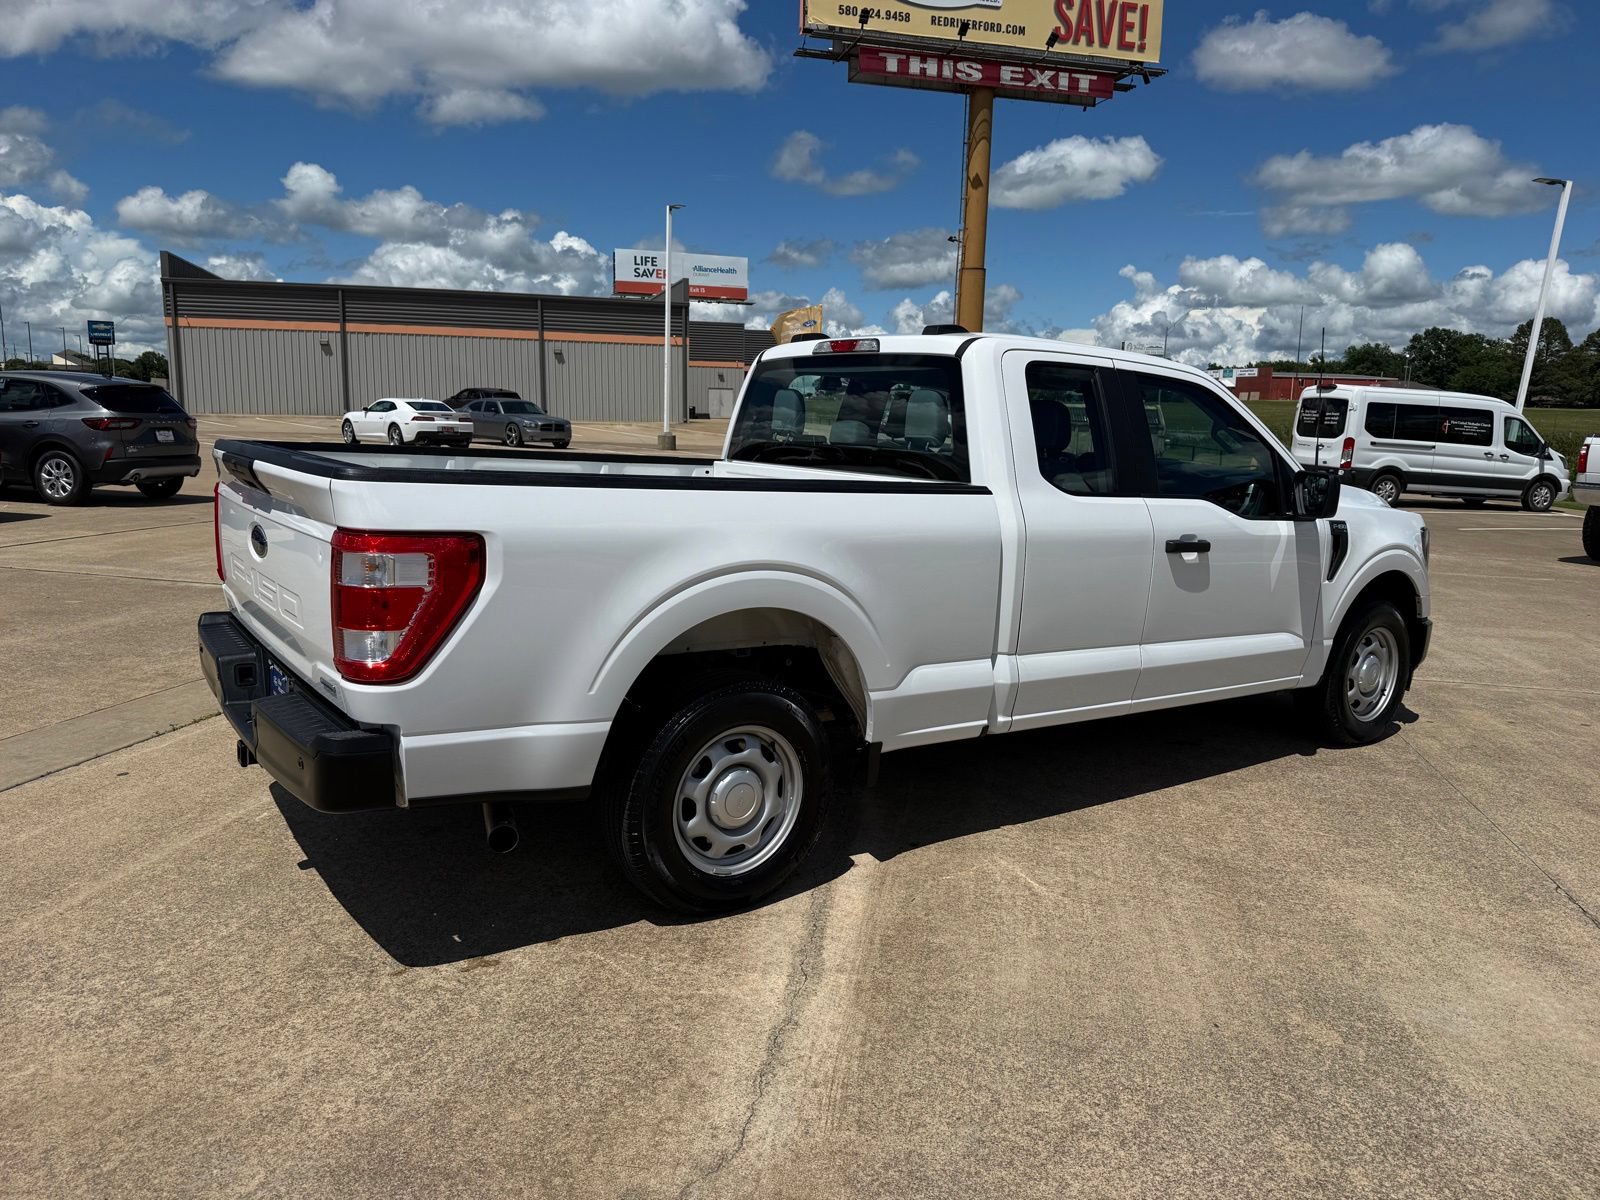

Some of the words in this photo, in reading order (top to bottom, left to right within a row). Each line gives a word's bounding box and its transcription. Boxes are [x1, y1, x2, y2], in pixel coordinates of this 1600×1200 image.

[838, 4, 911, 22] 580.24.9458
[1054, 0, 1149, 51] SAVE!
[879, 52, 983, 82] THIS
[1000, 65, 1098, 93] EXIT
[633, 255, 658, 267] LIFE
[692, 264, 737, 275] AllianceHealth
[633, 267, 667, 279] SAVE
[230, 551, 305, 630] F-150
